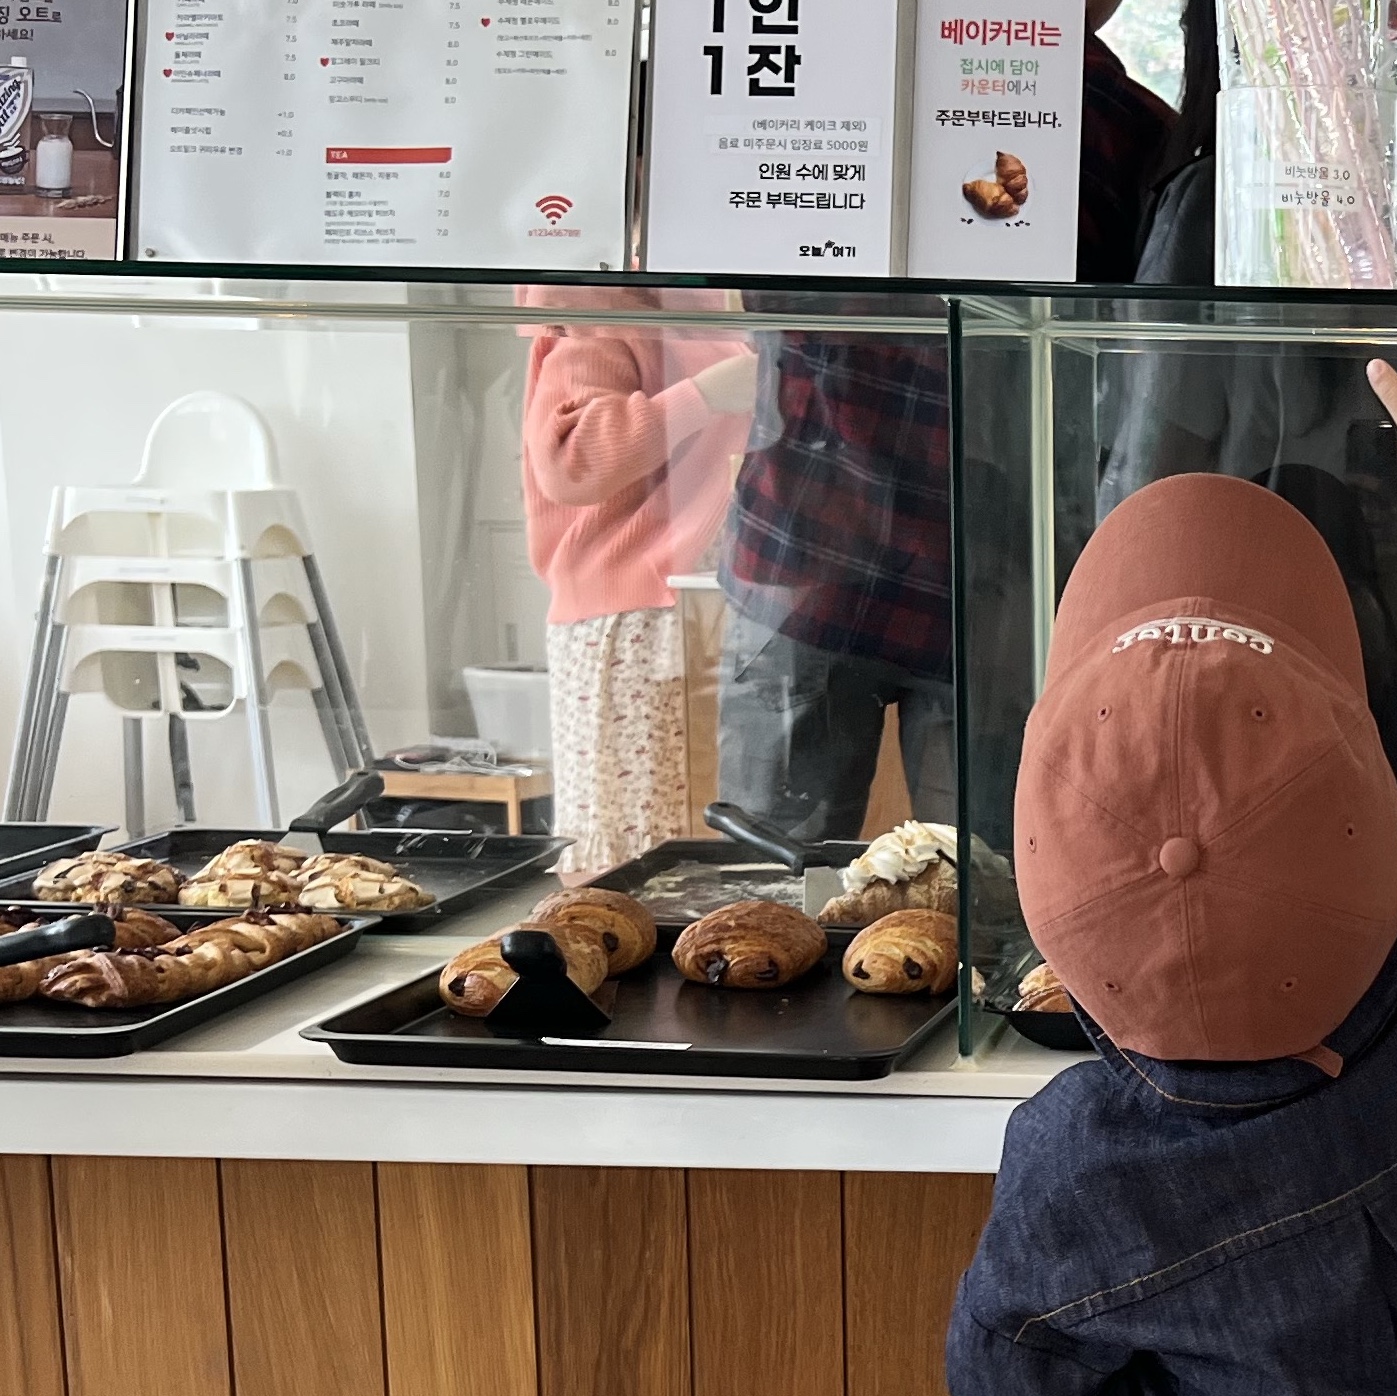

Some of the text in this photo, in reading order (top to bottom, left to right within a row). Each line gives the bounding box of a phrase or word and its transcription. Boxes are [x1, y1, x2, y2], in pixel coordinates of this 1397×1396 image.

[940, 19, 1062, 46] 베이커리는
[960, 58, 1040, 76] 접시에 담아
[960, 79, 1037, 96] 카운터에서
[752, 119, 867, 132] (베이커리 케이크 제외)
[935, 109, 1062, 129] 주문부탁드립니다.
[718, 137, 869, 152] 음료 미주문시 입장료 5000원
[758, 162, 867, 182] 인원 수에 맞게
[1285, 166, 1351, 181] 비눗방울 3.0
[728, 190, 867, 210] 주문 부탁드립니다
[1281, 190, 1331, 207] 비눗방울
